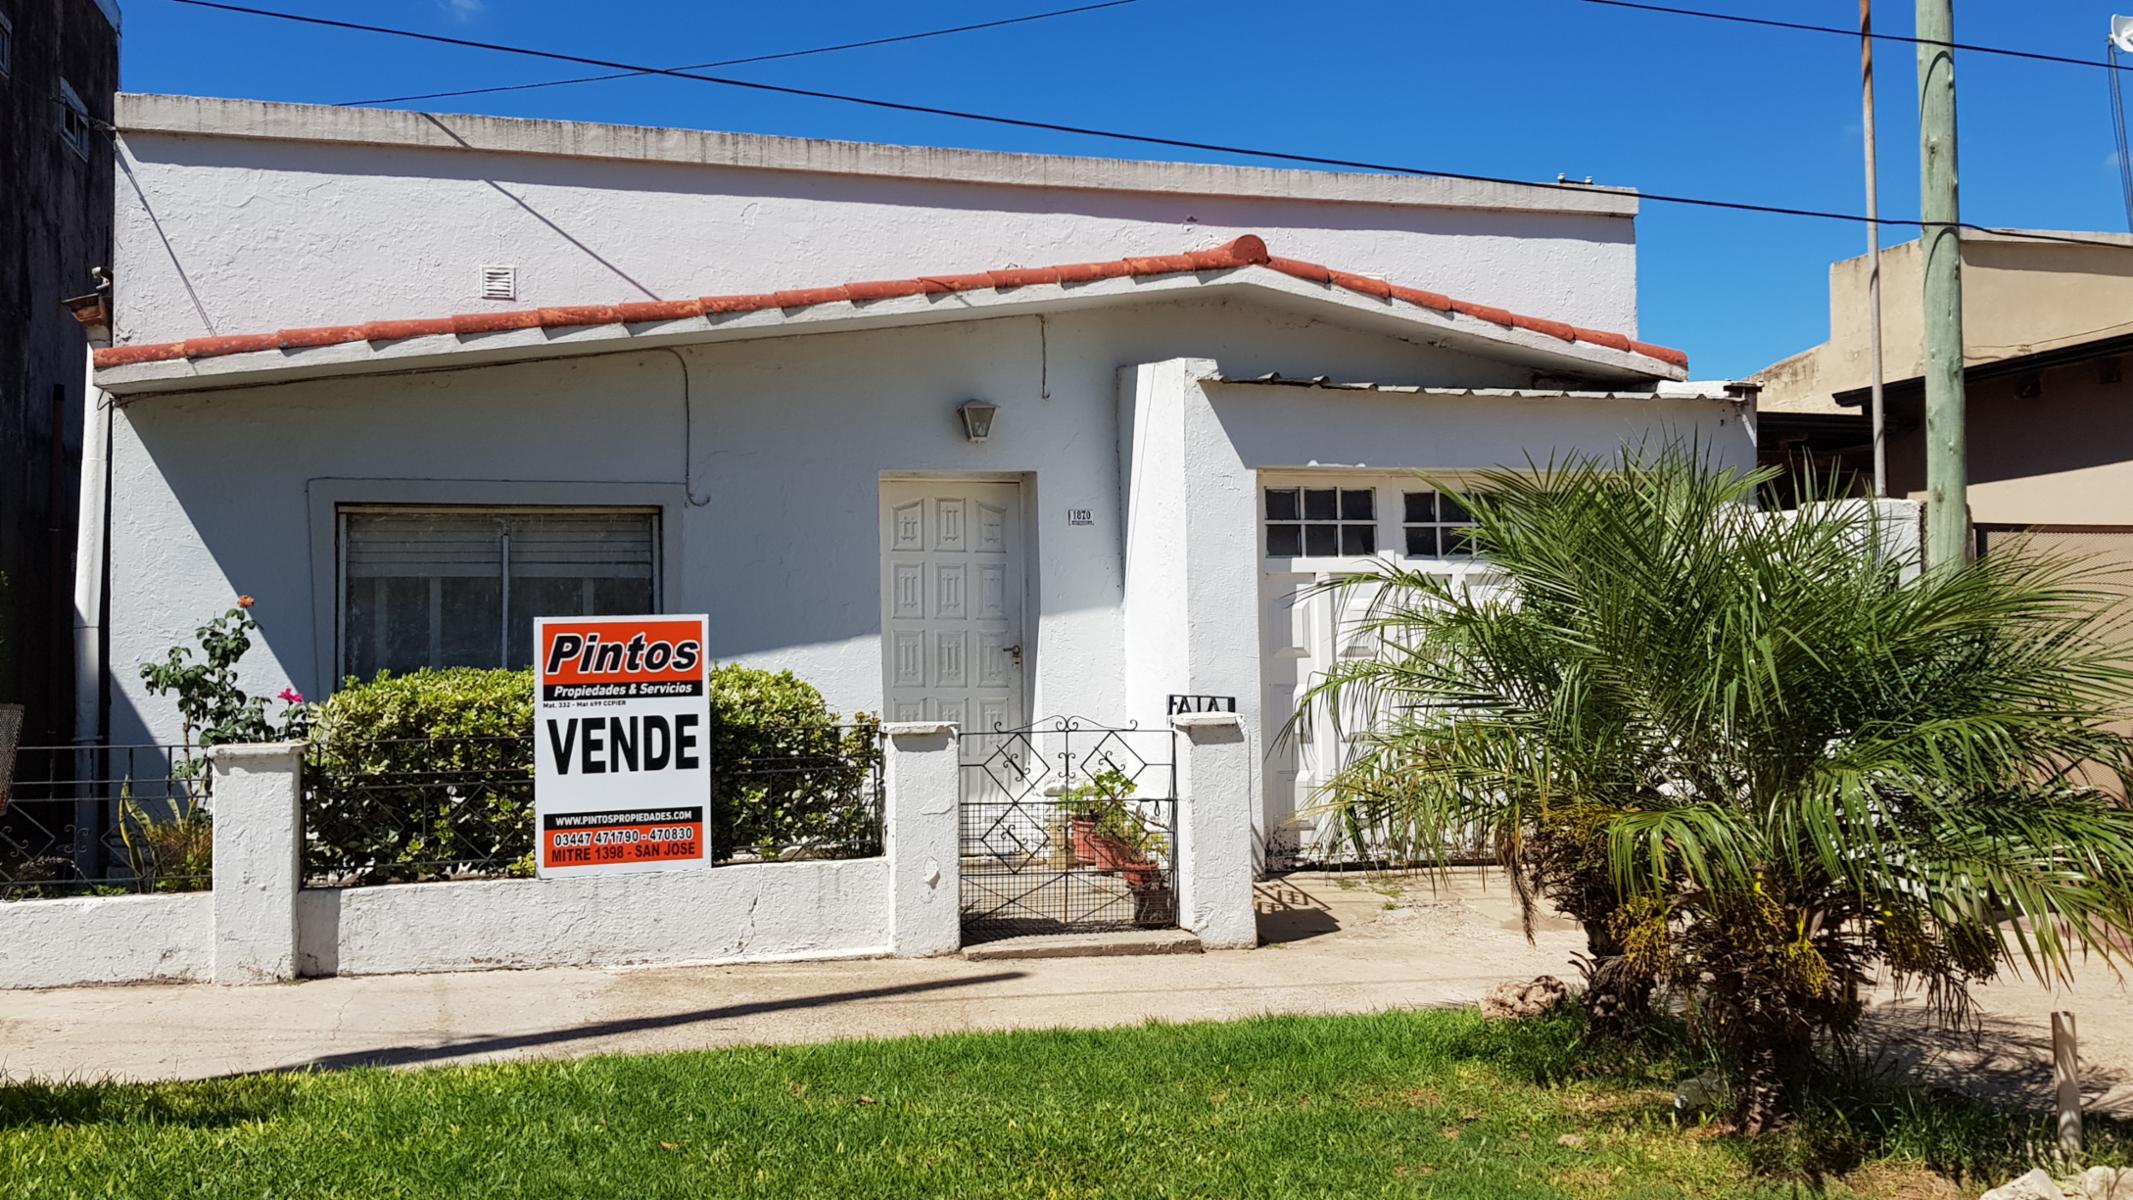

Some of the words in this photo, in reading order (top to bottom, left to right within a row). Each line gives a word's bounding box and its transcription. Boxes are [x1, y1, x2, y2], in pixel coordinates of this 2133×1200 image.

[545, 632, 700, 675] Pintos
[554, 684, 627, 699] Propiedades
[628, 683, 637, 695] &
[639, 682, 693, 695] Servicios
[547, 714, 699, 775] VENDE
[555, 810, 692, 827] WWW.PINTOSPROPIEDADES.COM
[553, 832, 592, 848] 03447
[594, 829, 640, 846] 471790
[649, 826, 694, 843] 470830
[551, 847, 591, 863] MITRE
[594, 845, 624, 860] 1398
[634, 843, 660, 858] SAN
[664, 841, 696, 857] JOSE
